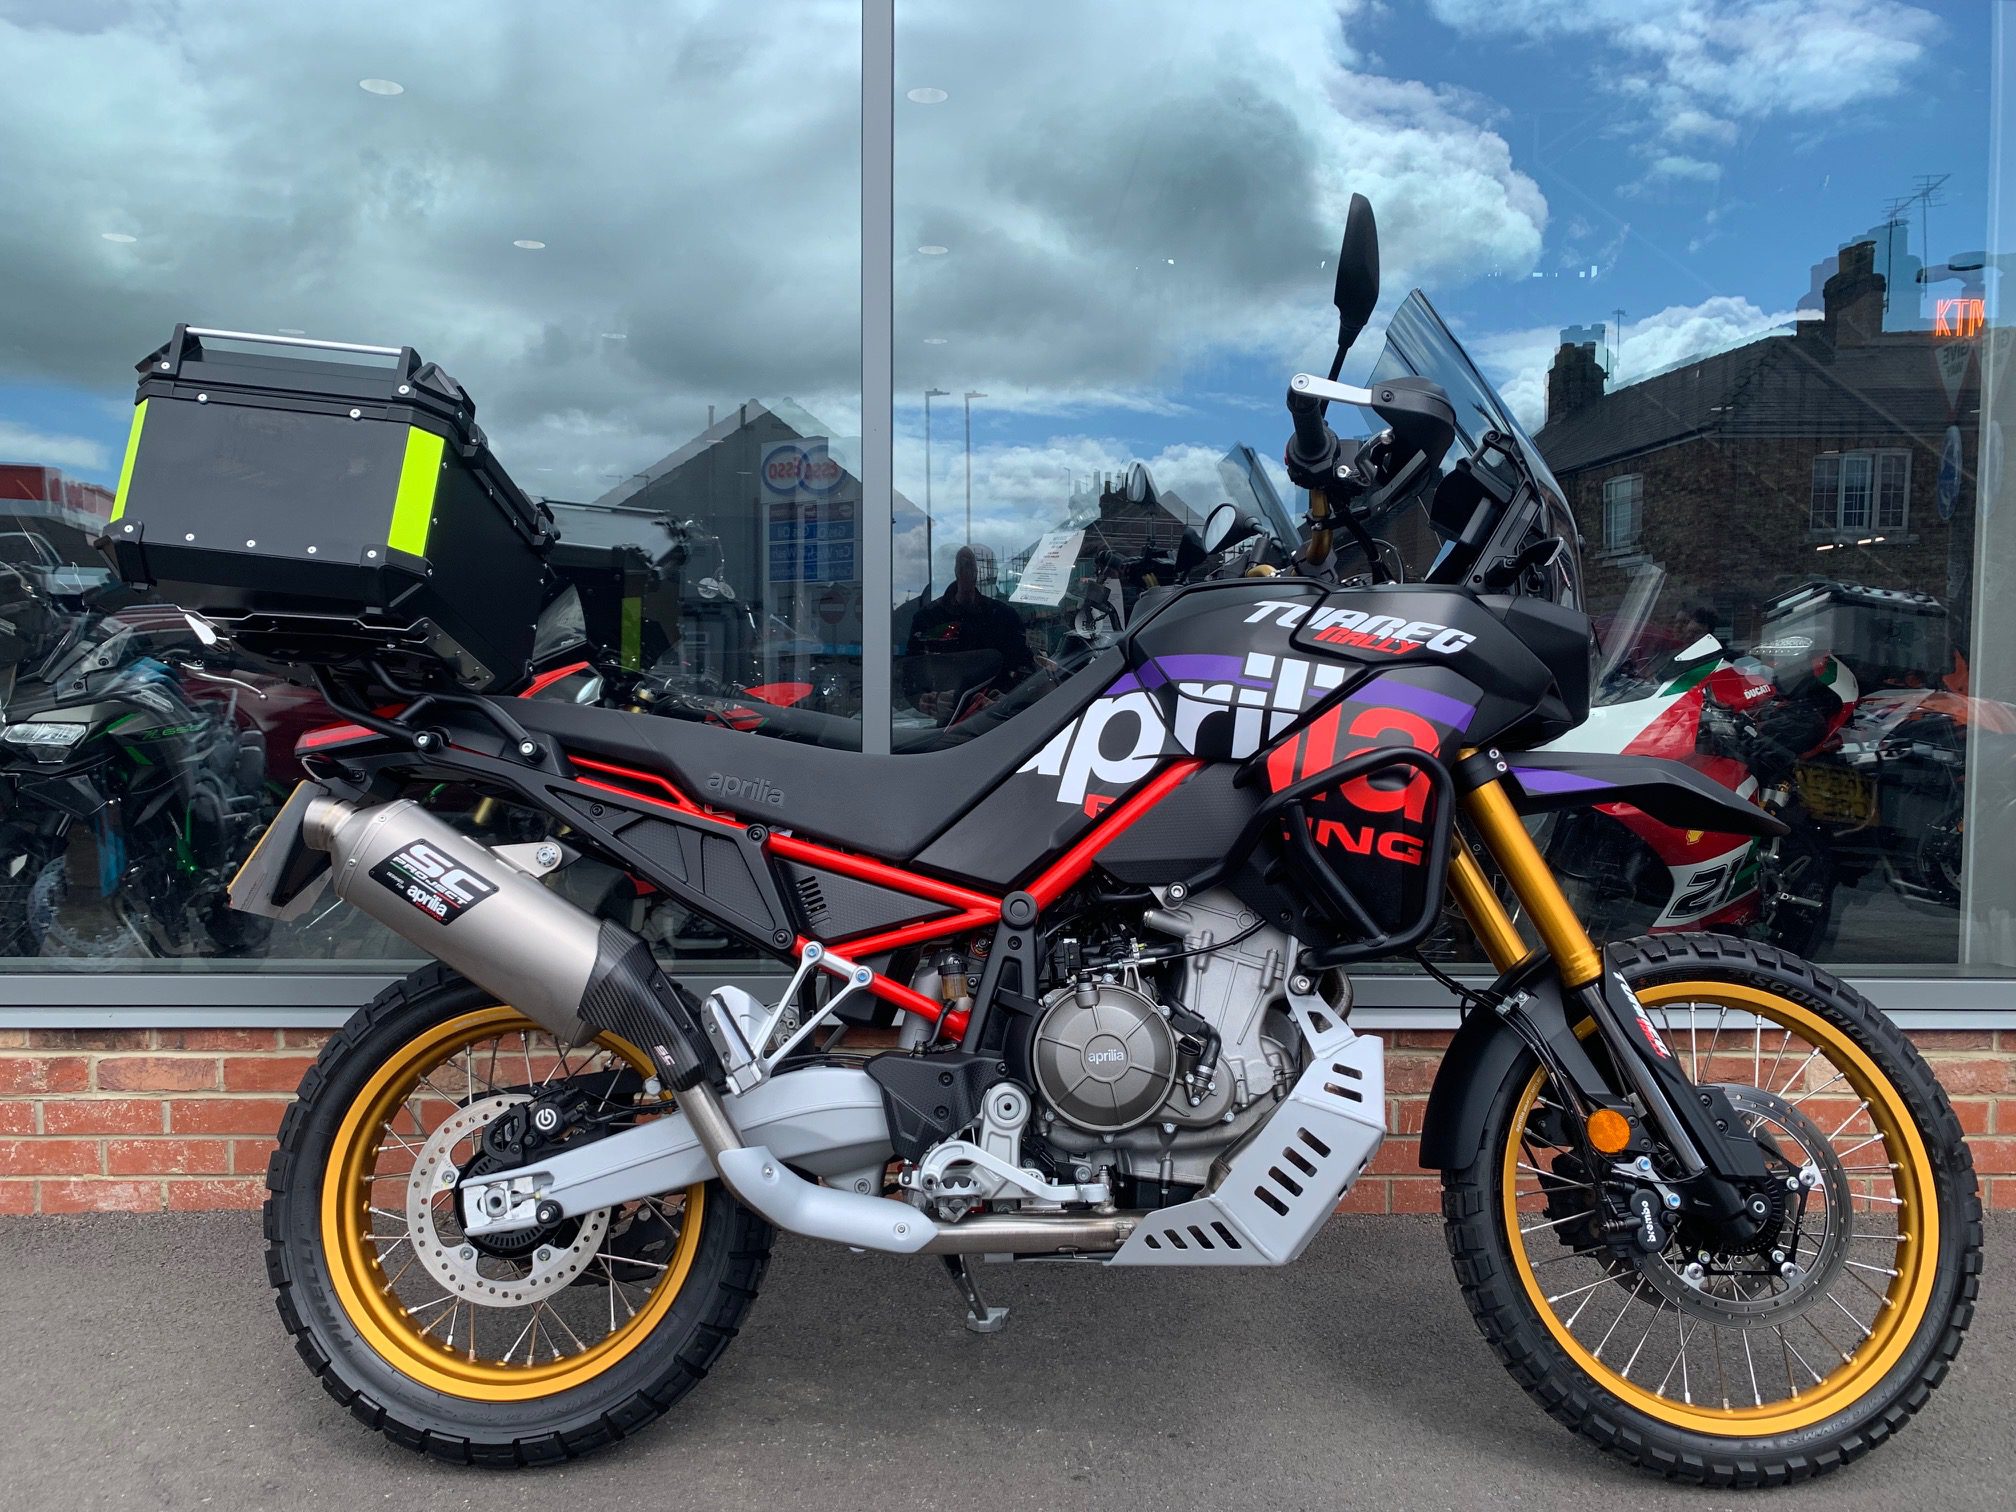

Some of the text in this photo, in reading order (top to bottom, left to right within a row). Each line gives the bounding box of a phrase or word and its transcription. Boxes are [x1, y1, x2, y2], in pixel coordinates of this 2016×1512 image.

[1935, 298, 1984, 337] KTM
[1243, 600, 1477, 654] TUAREG
[1313, 626, 1422, 655] RALLY
[1744, 684, 1771, 700] DUCATI
[705, 772, 785, 808] aprilia
[392, 856, 468, 905] PROJECT
[400, 844, 490, 902] SC
[1666, 853, 1747, 919] 21
[407, 884, 448, 917] aprilia
[1748, 975, 1884, 1054] SCORPION
[1088, 1049, 1124, 1065] aprilia
[1641, 1200, 1657, 1243] brembo
[293, 1236, 357, 1353] PIRELLI
